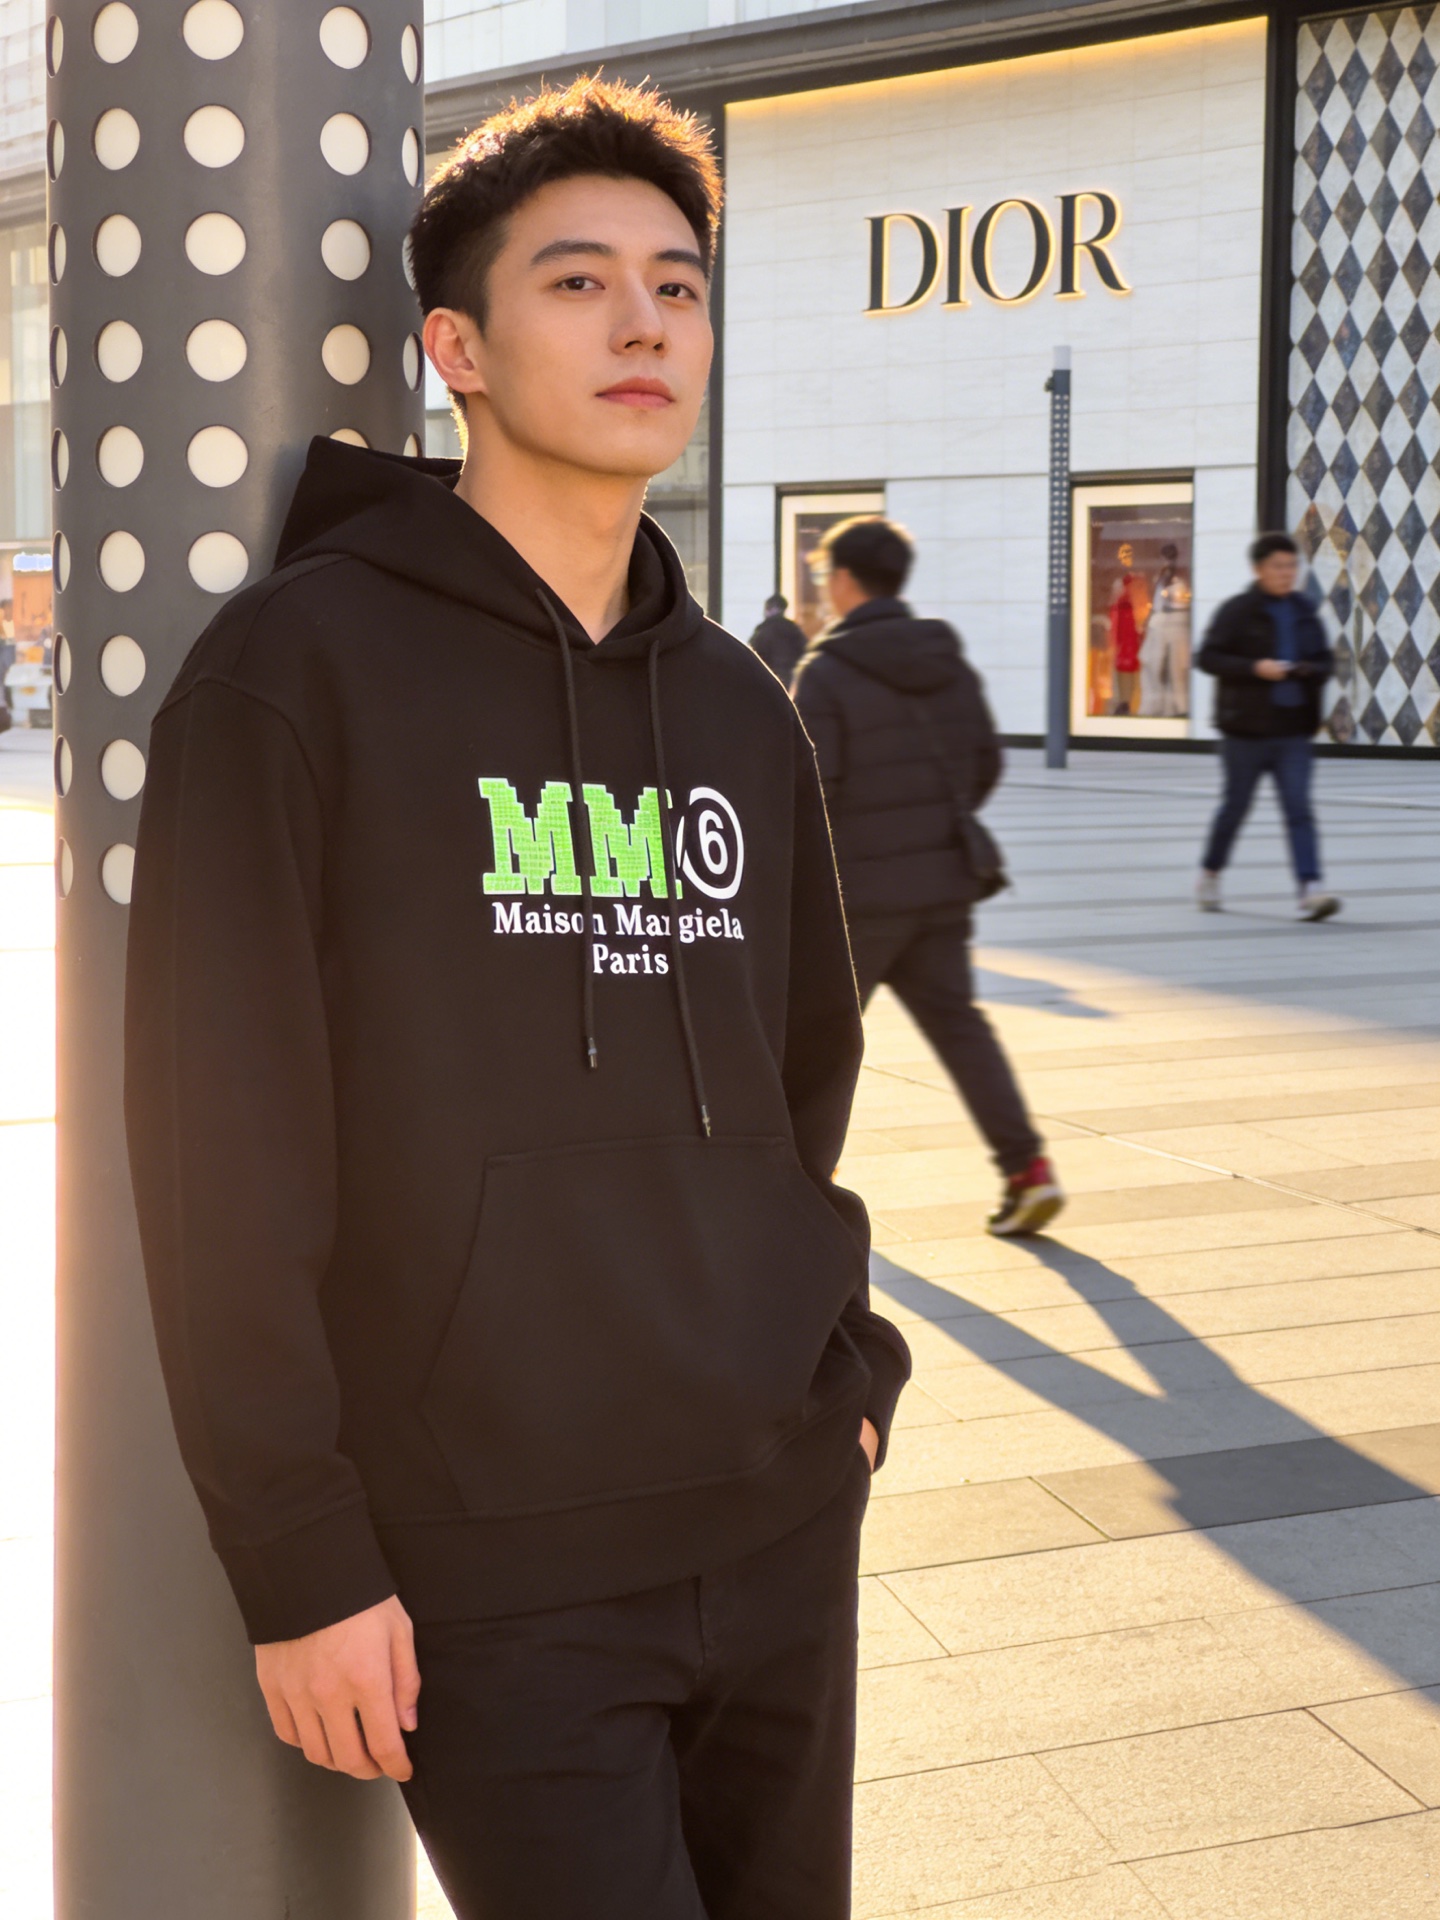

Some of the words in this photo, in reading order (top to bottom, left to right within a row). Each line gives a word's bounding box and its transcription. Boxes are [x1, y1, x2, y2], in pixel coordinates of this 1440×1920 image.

[863, 191, 1130, 314] DIOR
[492, 902, 607, 934] Maison
[592, 944, 669, 975] Paris
